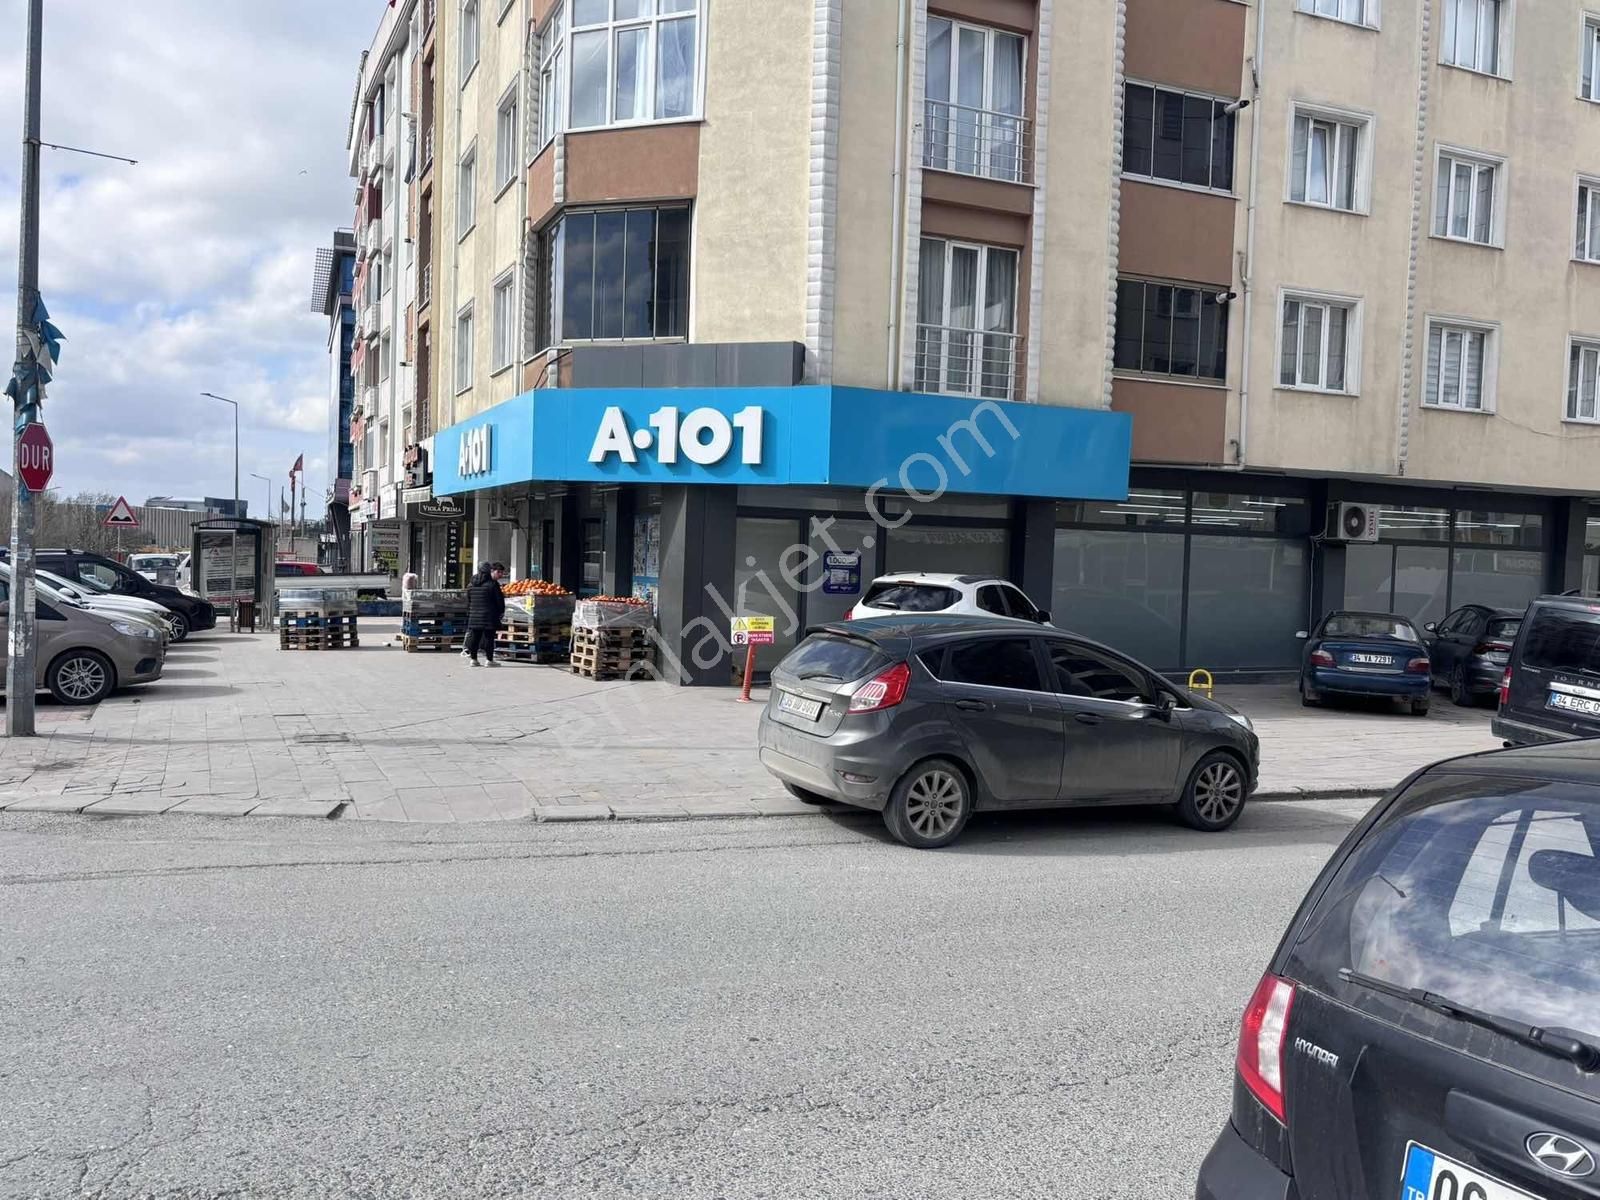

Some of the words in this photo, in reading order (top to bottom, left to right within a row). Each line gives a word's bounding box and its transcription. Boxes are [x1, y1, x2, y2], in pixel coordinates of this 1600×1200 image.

[21, 443, 50, 471] DUR
[1553, 674, 1600, 690] TORN
[1555, 694, 1567, 705] 34
[1570, 697, 1591, 710] ERC
[1294, 1037, 1339, 1067] HYUNDAI
